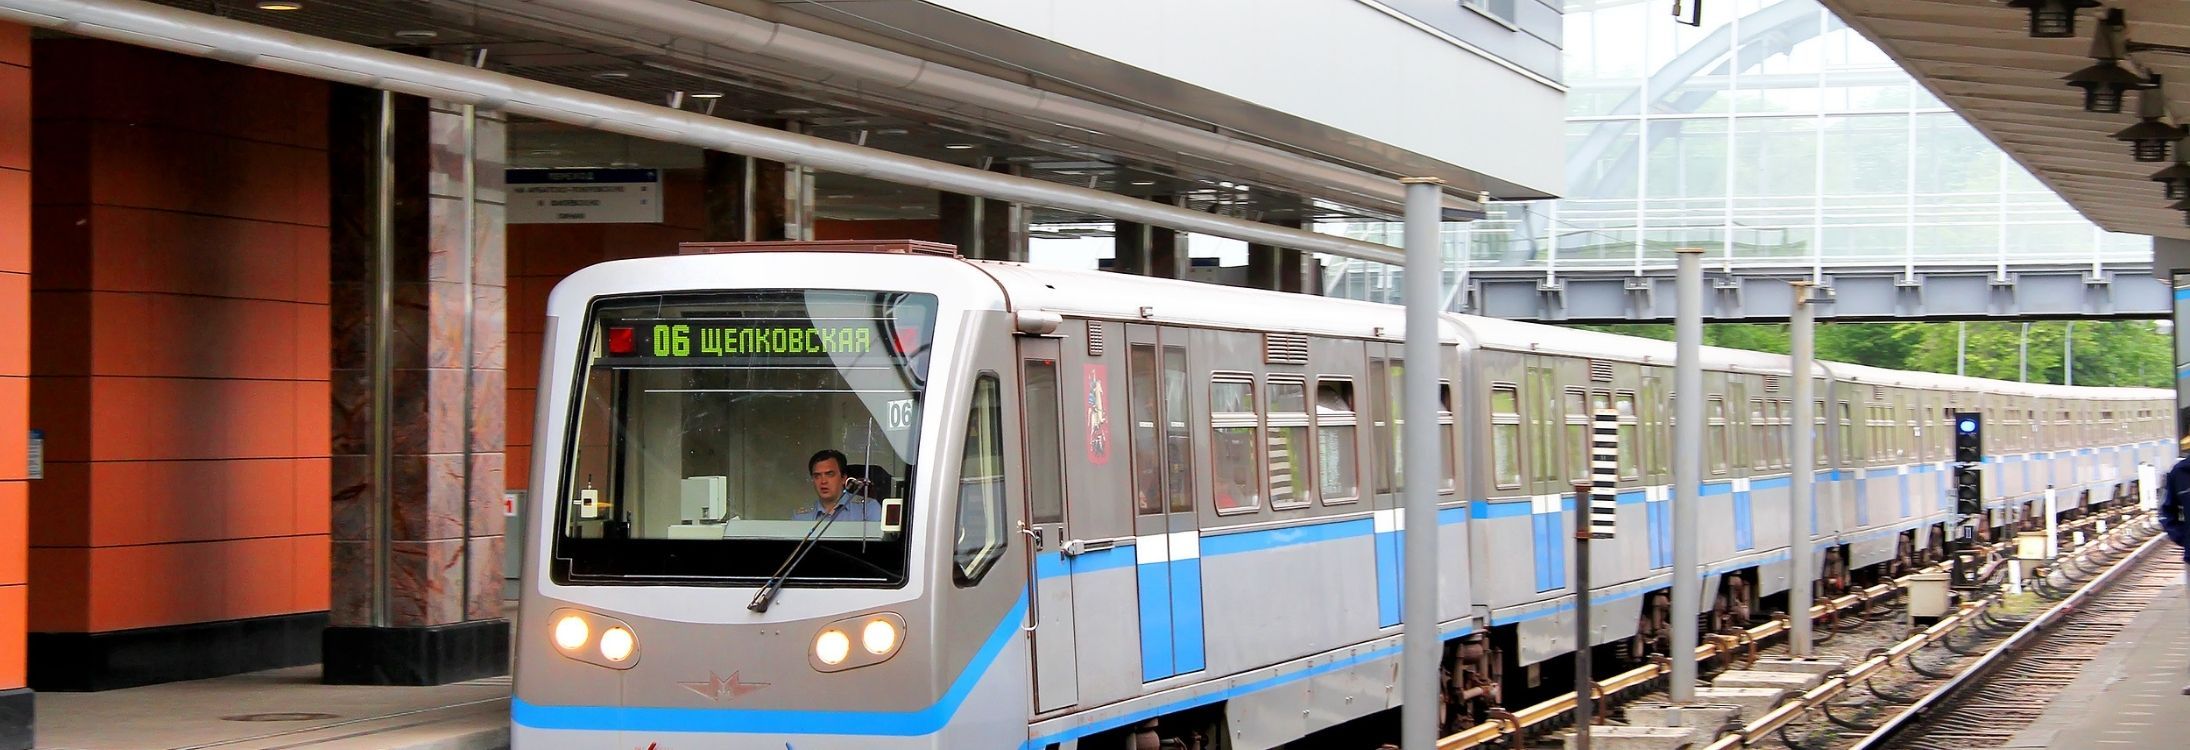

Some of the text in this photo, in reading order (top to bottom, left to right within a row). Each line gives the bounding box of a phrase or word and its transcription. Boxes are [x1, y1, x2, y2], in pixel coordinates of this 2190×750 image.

[653, 324, 870, 357] 06 ЩЕЛКОВСКАЯ
[890, 402, 912, 427] 06
